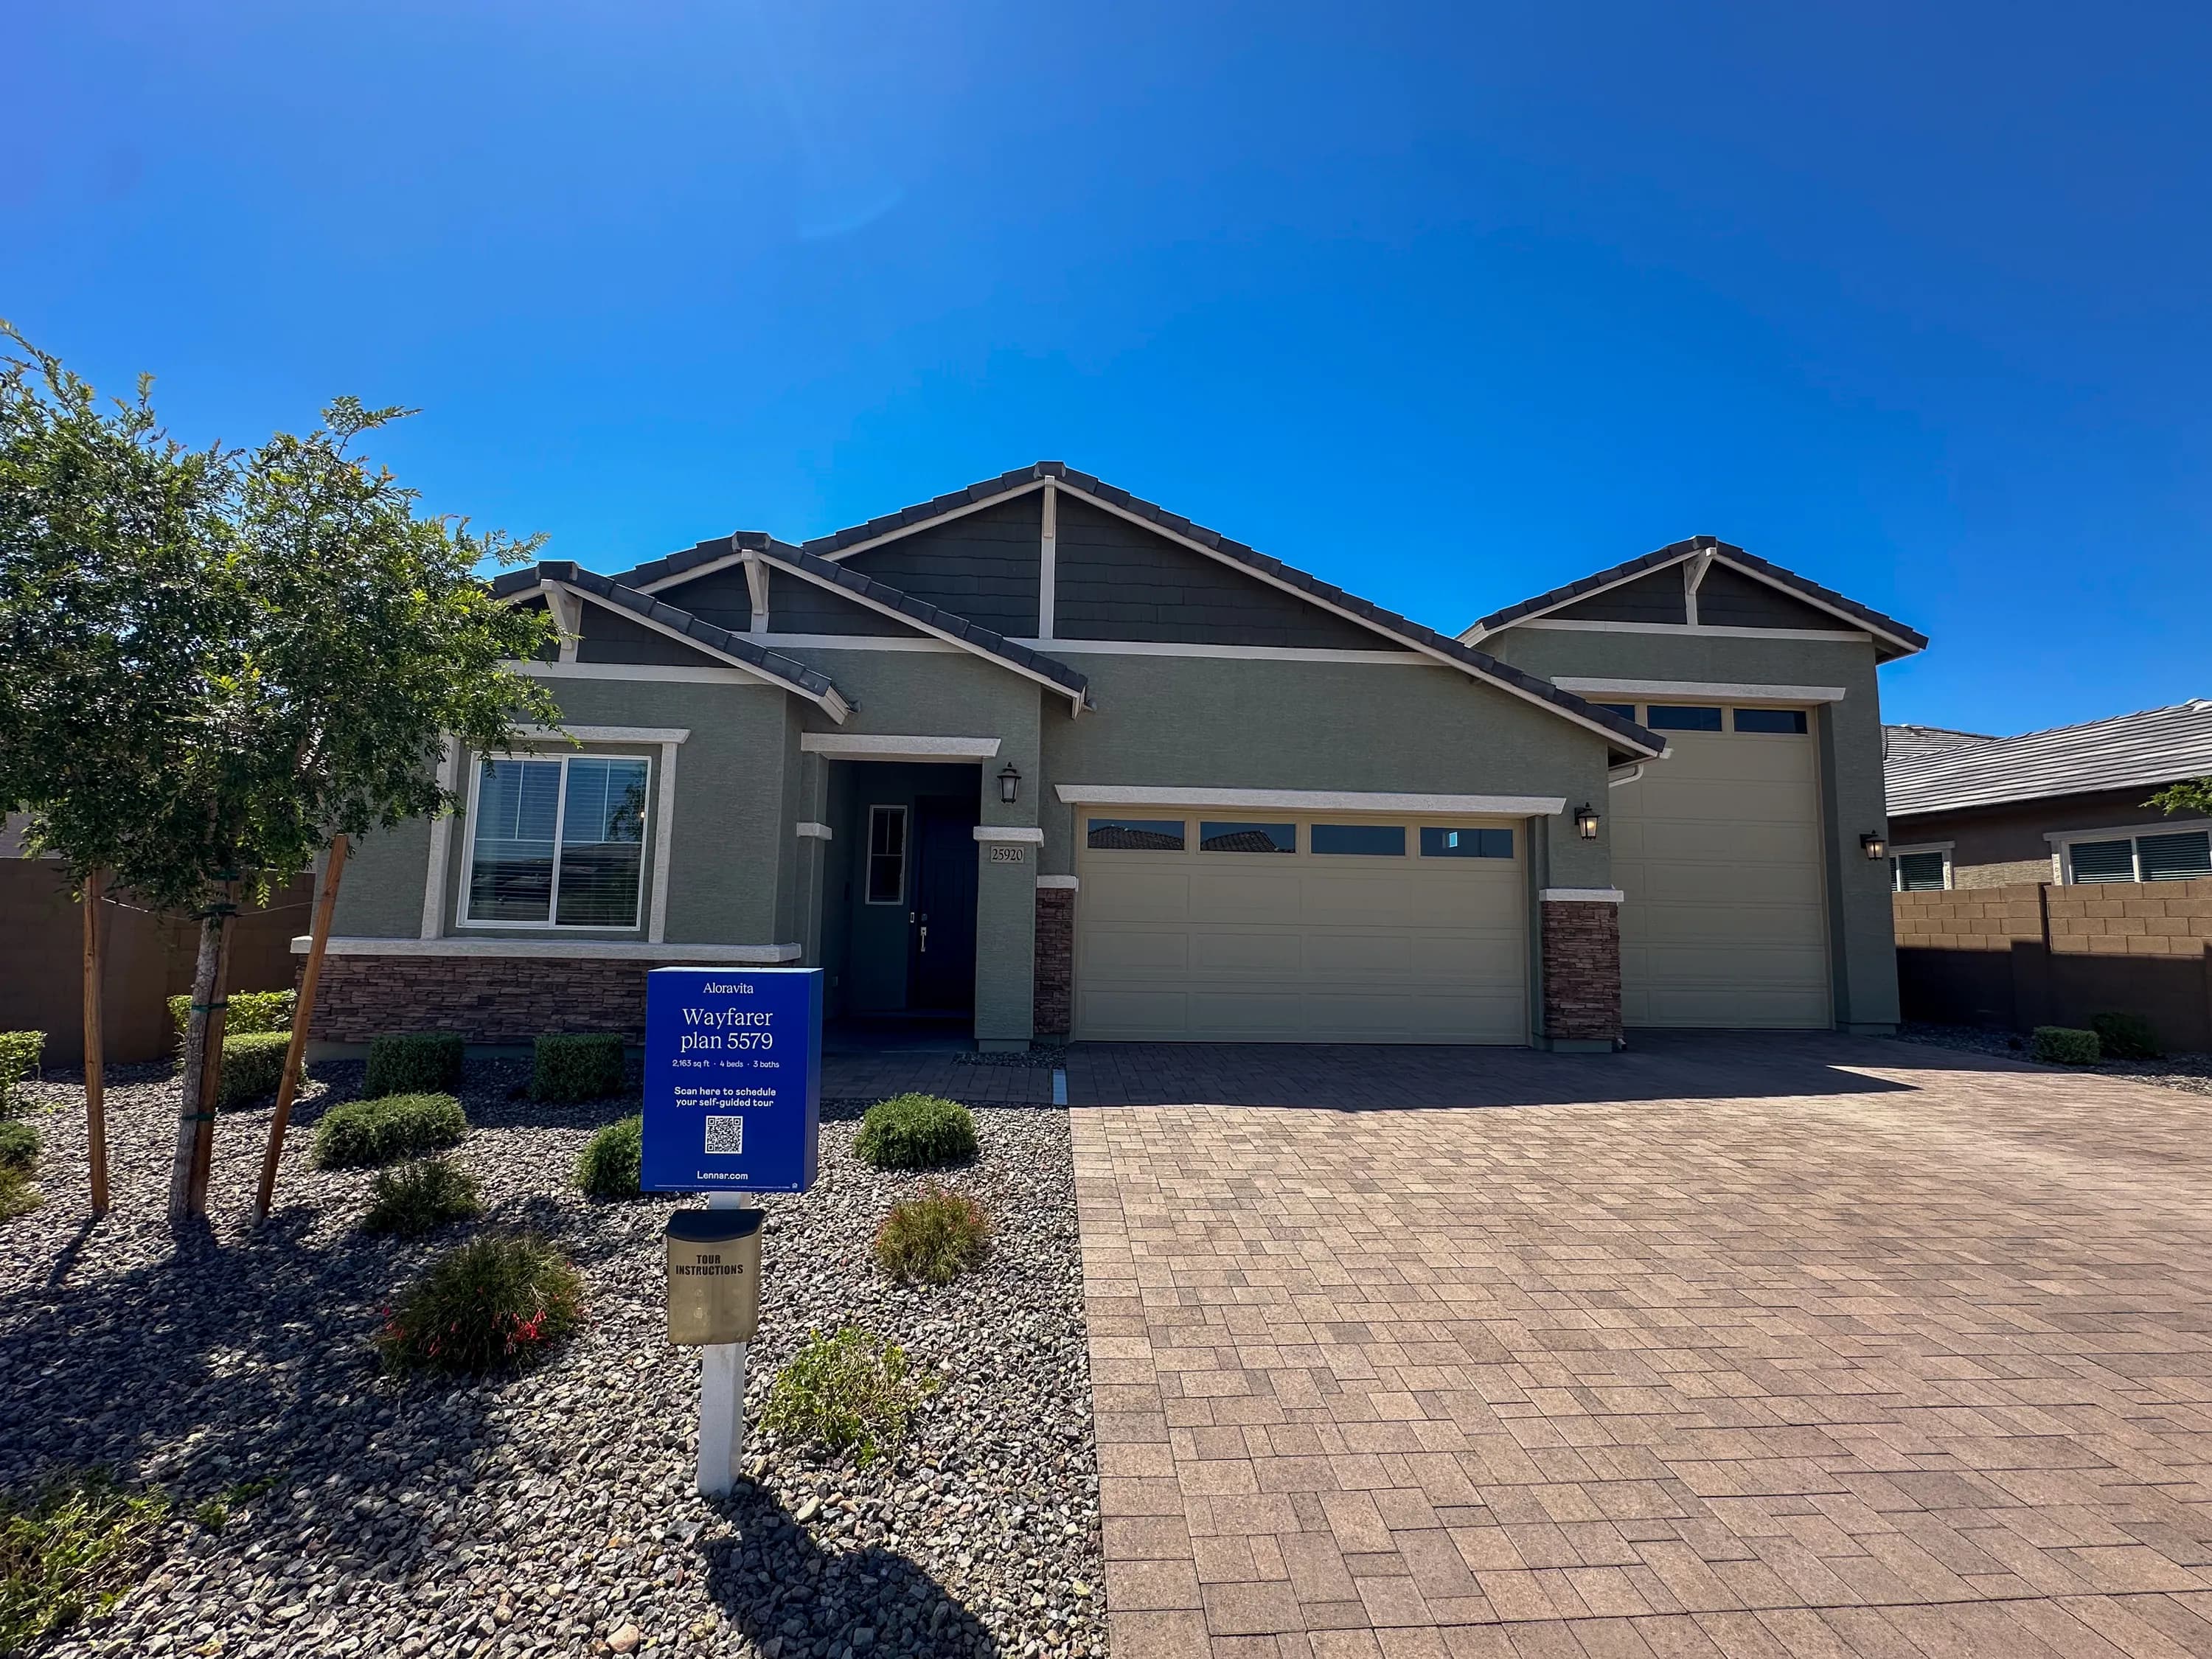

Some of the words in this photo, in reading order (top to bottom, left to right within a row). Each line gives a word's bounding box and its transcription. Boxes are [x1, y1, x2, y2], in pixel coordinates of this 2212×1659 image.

[992, 848, 1023, 861] 25920
[703, 982, 754, 994] Aloravita
[682, 1007, 773, 1030] Wayfarer
[680, 1031, 723, 1053] plan
[727, 1032, 773, 1050] 5579
[672, 1059, 692, 1068] 2,163
[703, 1060, 710, 1068] ft
[759, 1060, 780, 1068] baths
[674, 1086, 698, 1096] Scan
[699, 1086, 721, 1096] here
[723, 1088, 734, 1096] to
[735, 1087, 776, 1096] schedule
[675, 1098, 698, 1107] your
[699, 1097, 751, 1108] self-guided
[752, 1099, 774, 1107] tour
[697, 1170, 748, 1180] Lennar.com
[696, 1254, 721, 1265] TOUR
[675, 1264, 744, 1276] INSTRUCTIONS
